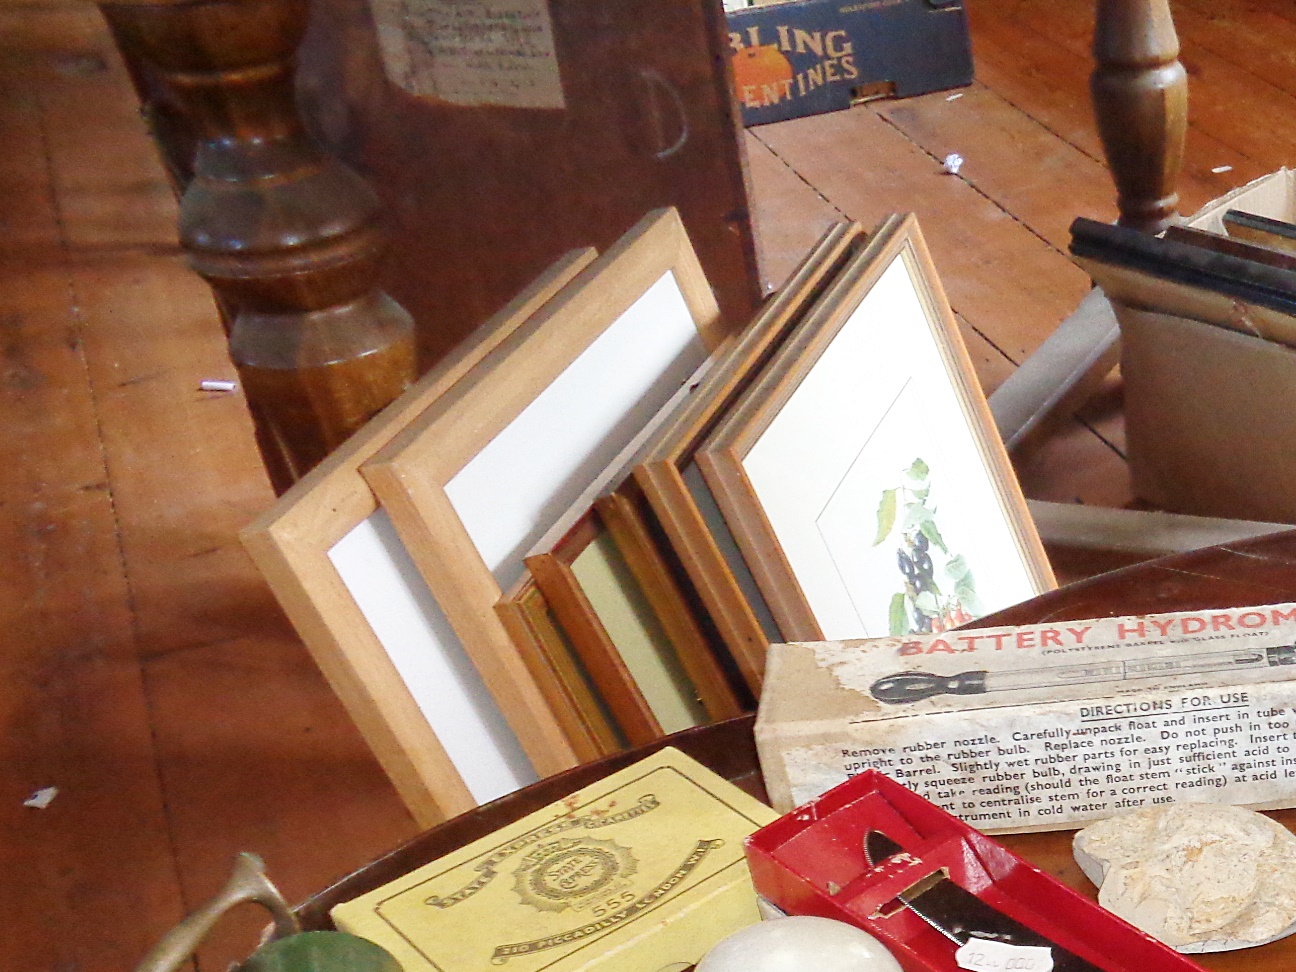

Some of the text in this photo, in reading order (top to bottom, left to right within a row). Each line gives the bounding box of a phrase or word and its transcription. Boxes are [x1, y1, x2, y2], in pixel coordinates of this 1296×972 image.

[728, 25, 853, 58] RLING
[743, 57, 859, 108] ENTINES
[899, 626, 1092, 657] BATTERY
[1080, 692, 1250, 718] DIRECTIONS FOR USE
[842, 747, 895, 758] Remove
[903, 740, 946, 753] rubber
[954, 735, 1000, 748] nozzle.
[1012, 728, 1073, 742] Carefully
[1077, 723, 1122, 736] unpack
[1128, 720, 1158, 731] float
[1163, 716, 1186, 727] and
[1193, 714, 1231, 724] insert
[1238, 711, 1250, 720] in
[1257, 708, 1286, 718] tube
[844, 758, 894, 772] upright
[900, 756, 913, 765] to
[920, 753, 941, 763] the
[948, 749, 991, 760] rubber
[998, 746, 1030, 756] bulb.
[1045, 739, 1094, 752] Replace
[1101, 734, 1147, 746] nozzle.
[1161, 730, 1179, 740] Do
[1185, 728, 1206, 738] not
[1213, 724, 1242, 736] push
[1250, 722, 1261, 731] in
[1268, 720, 1289, 729] too
[896, 765, 941, 778] Barrel.
[951, 761, 1000, 774] Slightly
[1007, 759, 1030, 768] wet
[1034, 752, 1078, 765] rubber
[1083, 750, 1115, 763] parts
[1120, 748, 1139, 757] for
[1144, 745, 1171, 755] easy
[1176, 738, 1238, 752] replacing.
[1250, 733, 1288, 744] Insert
[924, 775, 975, 789] squeeze
[982, 770, 1026, 783] rubber
[1032, 767, 1066, 778] bulb,
[1070, 762, 1122, 775] drawing
[1129, 760, 1141, 768] in
[1148, 757, 1172, 769] just
[1179, 750, 1238, 763] sufficient
[1244, 747, 1270, 757] acid
[1277, 745, 1290, 753] to
[963, 800, 976, 809] to
[980, 794, 1043, 808] centralise
[1048, 792, 1080, 803] stem
[1086, 788, 1106, 798] for
[1122, 783, 1169, 795] correct
[1175, 775, 1228, 789] reading)
[1235, 775, 1248, 784] at
[1252, 771, 1277, 781] acid
[972, 784, 1020, 798] reading
[1025, 778, 1072, 794] (should
[1079, 777, 1100, 787] the
[1106, 773, 1135, 783] float
[1140, 770, 1171, 781] stem
[1231, 759, 1277, 772] against
[954, 795, 1176, 822] trument in cold water after use.
[537, 911, 627, 950] PICCADILLY
[636, 870, 687, 908] LONDON
[592, 891, 635, 917] 555
